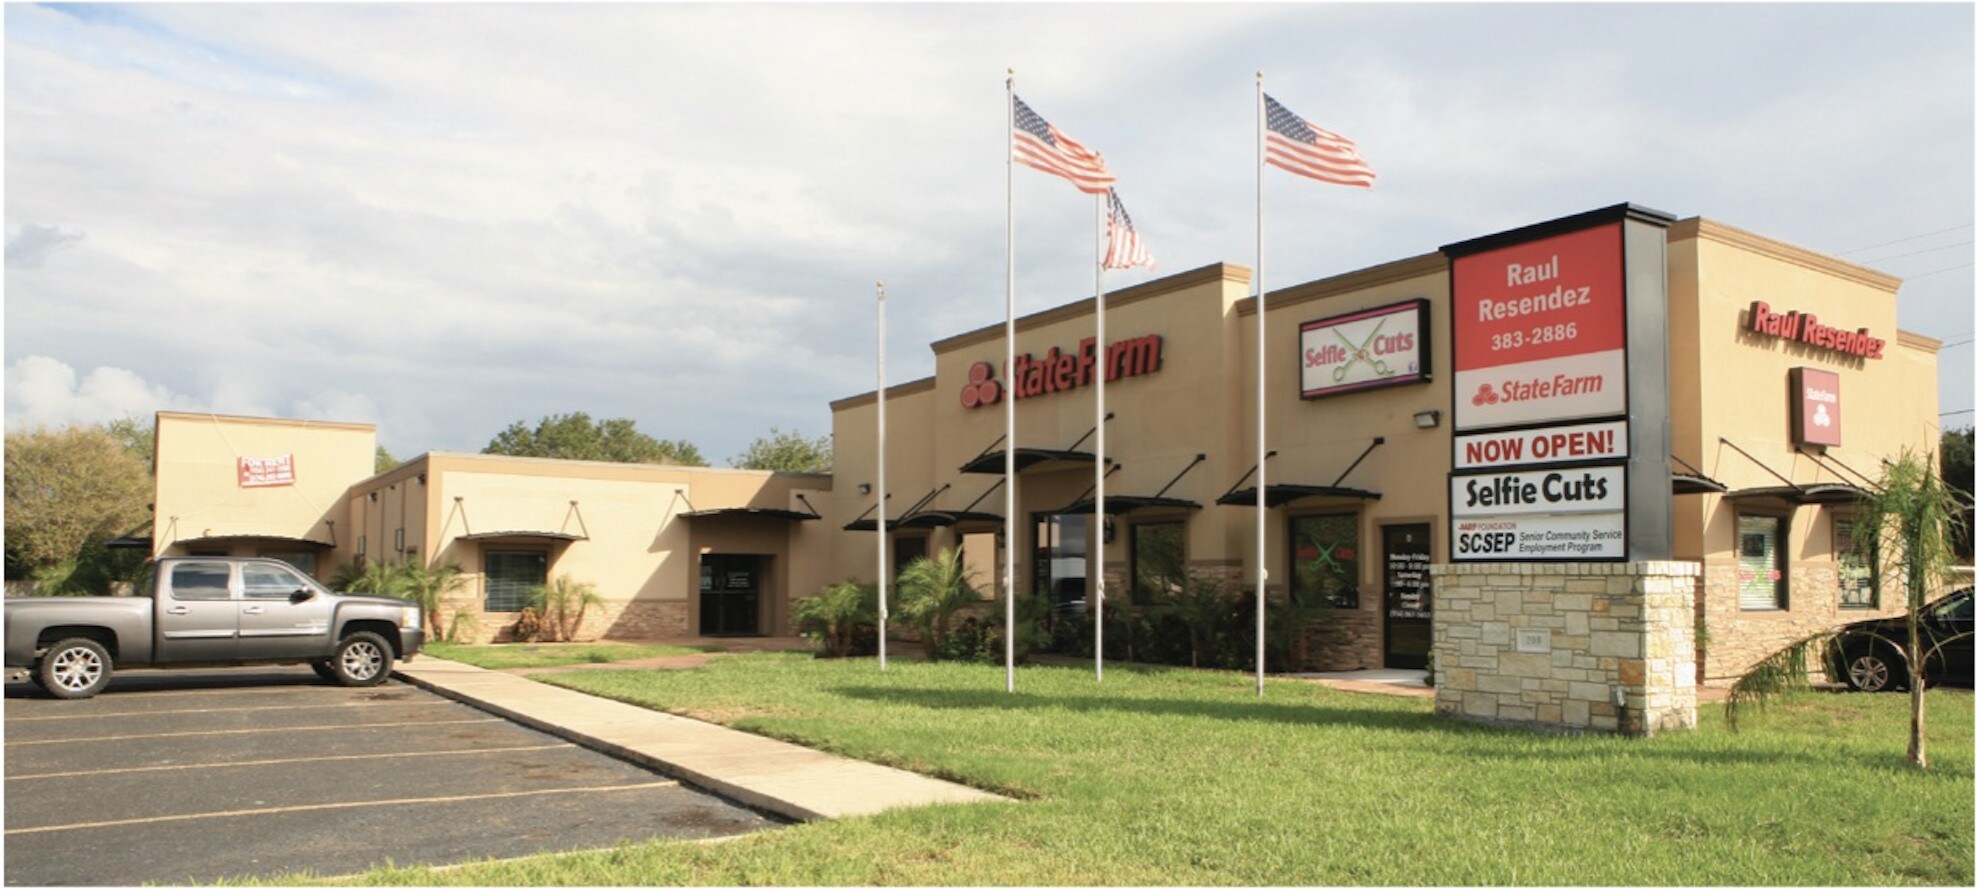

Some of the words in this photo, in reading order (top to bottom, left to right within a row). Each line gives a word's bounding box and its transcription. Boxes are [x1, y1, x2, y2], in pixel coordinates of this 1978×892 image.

[1507, 254, 1559, 287] Raul
[1478, 285, 1591, 322] Resendez
[1491, 322, 1578, 351] 383-2886
[1753, 300, 1800, 340] Raul
[1802, 313, 1886, 360] Resendez
[1305, 344, 1347, 368] Selfie
[1373, 331, 1414, 356] Cuts
[1466, 437, 1524, 464] NOW
[1531, 430, 1614, 459] OPEN!
[1466, 476, 1537, 507] Selfie
[1542, 473, 1607, 502] Cuts
[1458, 532, 1515, 553] SCSEP
[1477, 522, 1517, 530] FOUNDATION
[1519, 531, 1544, 542] Senior
[1545, 530, 1590, 542] Community
[1592, 529, 1622, 540] Service
[1519, 543, 1566, 555] Employment
[1567, 541, 1603, 554] Program
